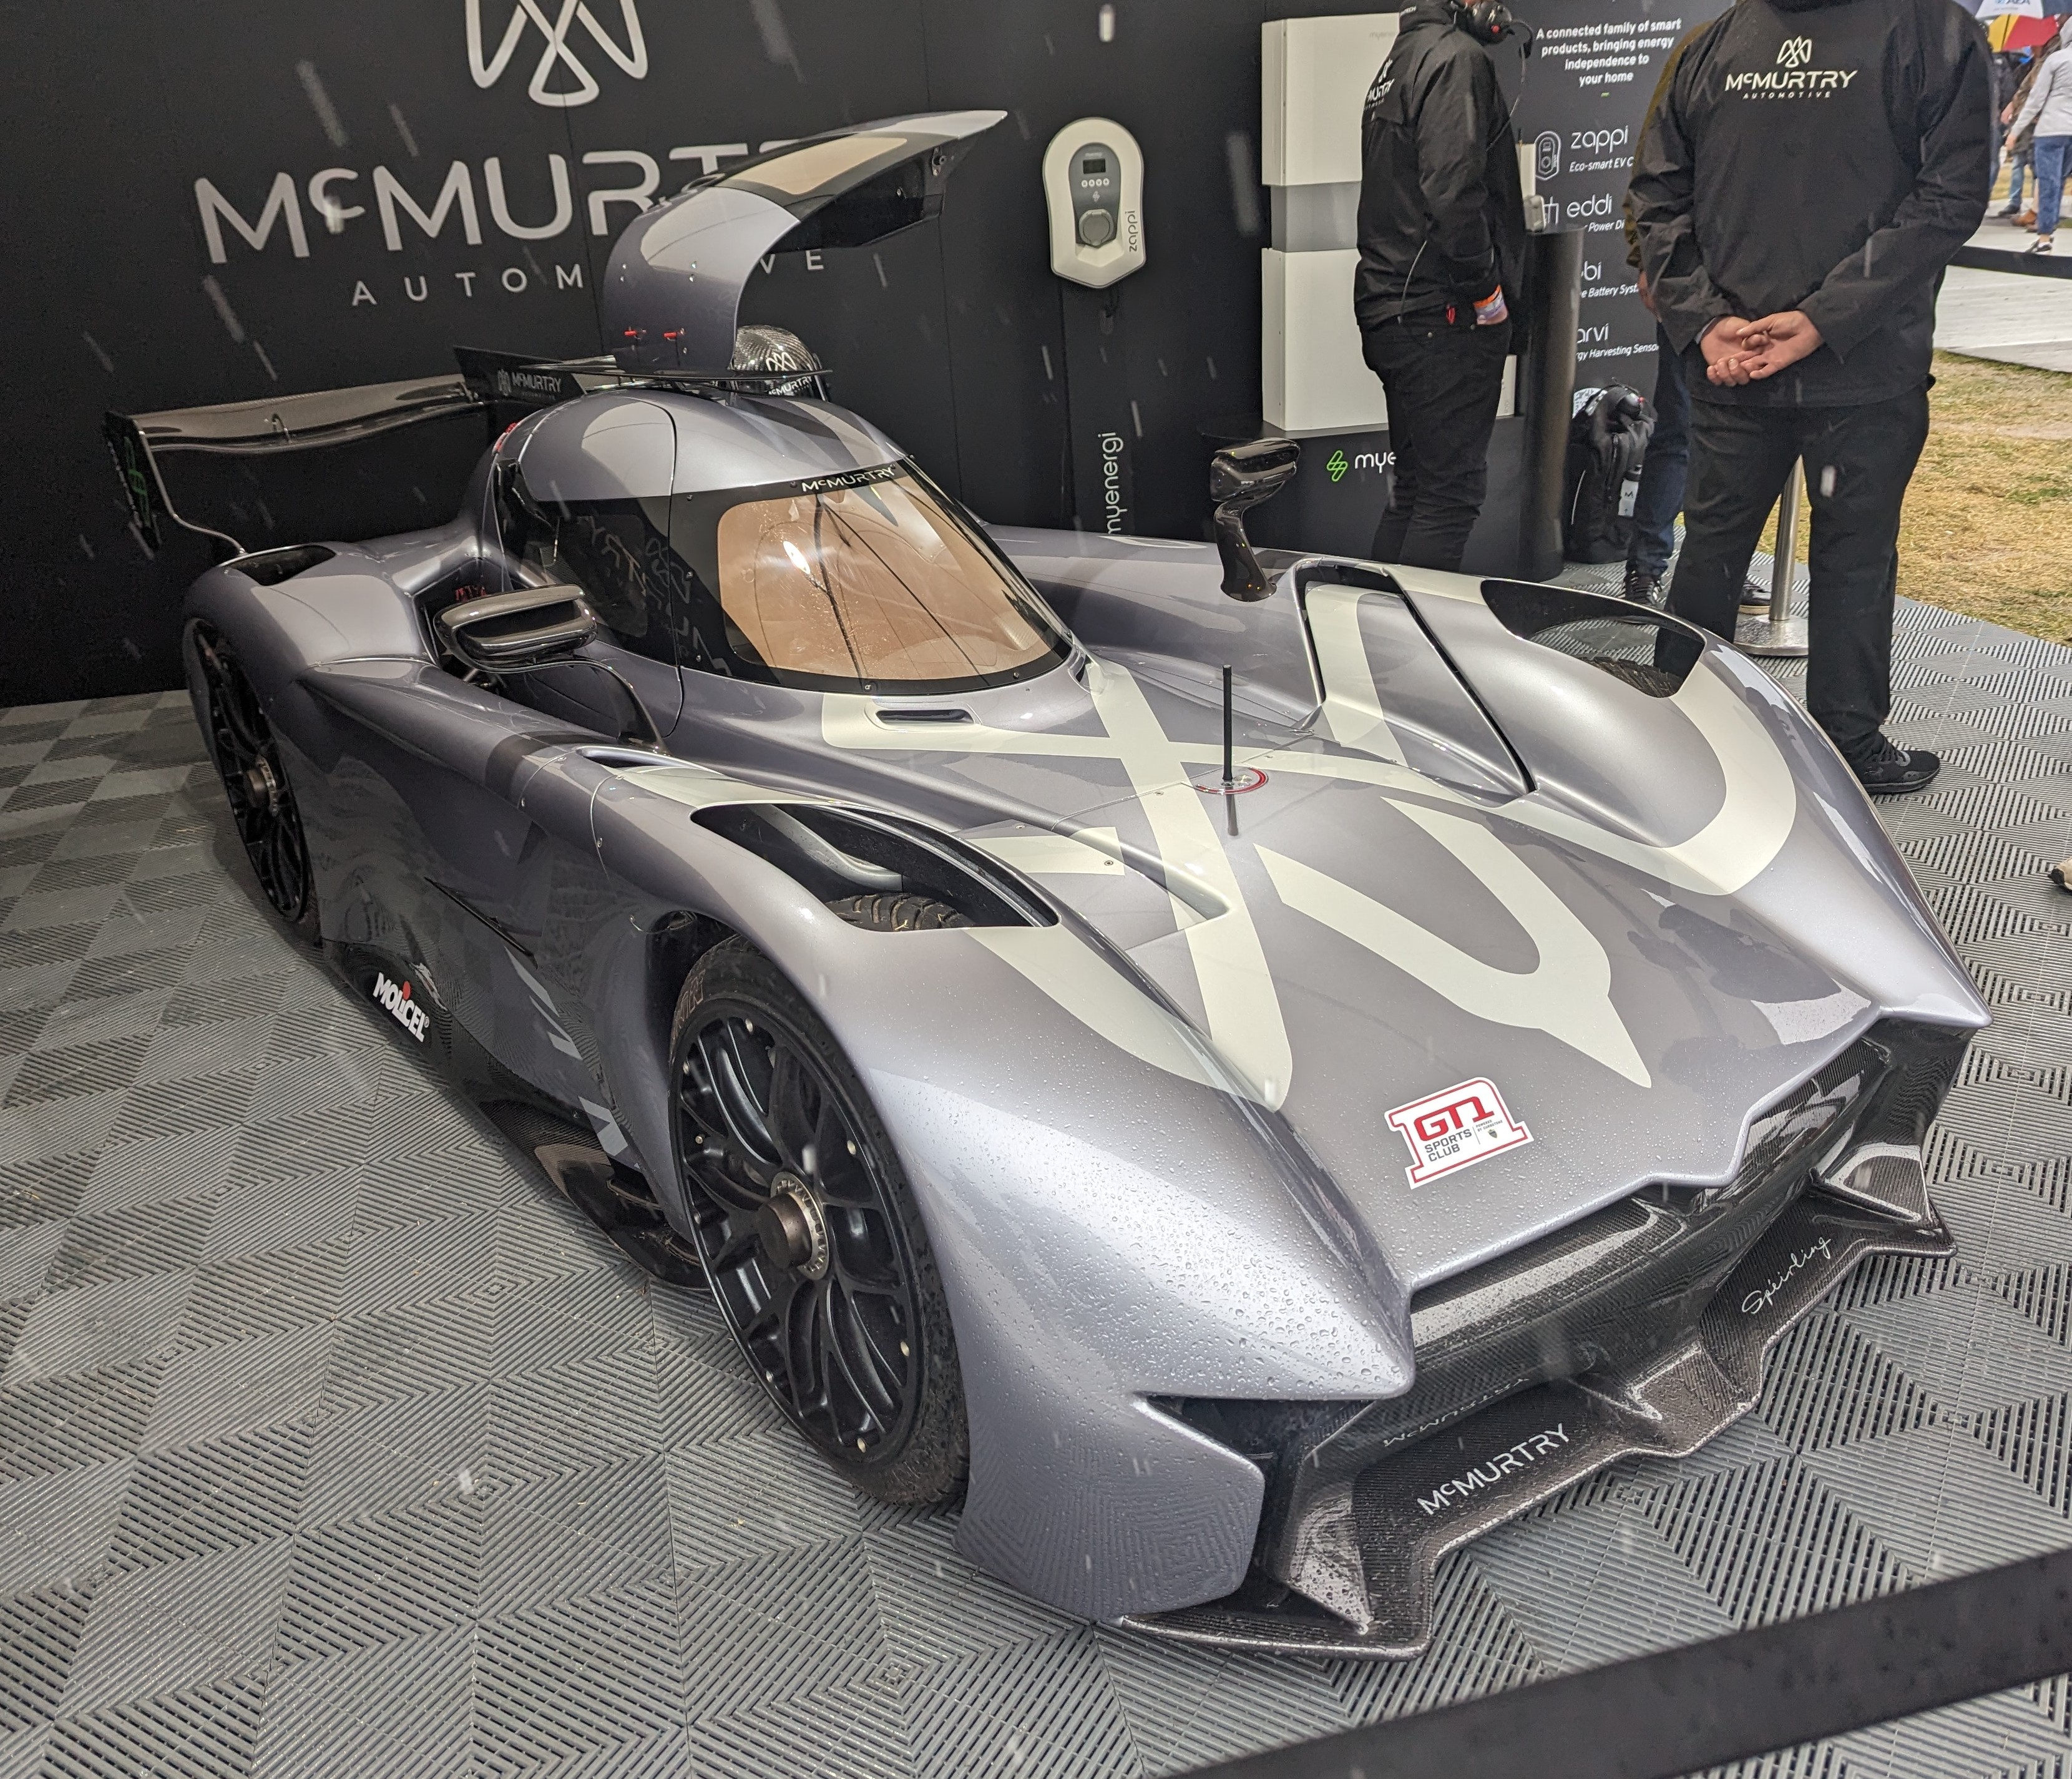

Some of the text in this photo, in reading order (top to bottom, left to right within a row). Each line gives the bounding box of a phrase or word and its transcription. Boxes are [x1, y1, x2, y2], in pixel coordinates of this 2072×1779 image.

[1536, 17, 1682, 41] A connected family of smart
[1542, 36, 1674, 59] products, bringing energy
[1564, 53, 1649, 71] independence to
[1579, 72, 1634, 88] your home
[1742, 91, 1830, 100] AUTOMOTIVE
[1571, 125, 1629, 155] zappi
[1569, 159, 1613, 172] Eco-smart
[1614, 157, 1627, 169] EV
[1566, 193, 1613, 218] eddi
[1125, 210, 1138, 252] zappi
[1588, 222, 1615, 233] Power
[1588, 287, 1619, 297] Battery
[1620, 283, 1640, 296] Syst
[1589, 345, 1632, 358] Harvesting
[1414, 1096, 1495, 1142] GT1
[1424, 1129, 1472, 1154] SPORTS
[1428, 1143, 1460, 1162] CLUB
